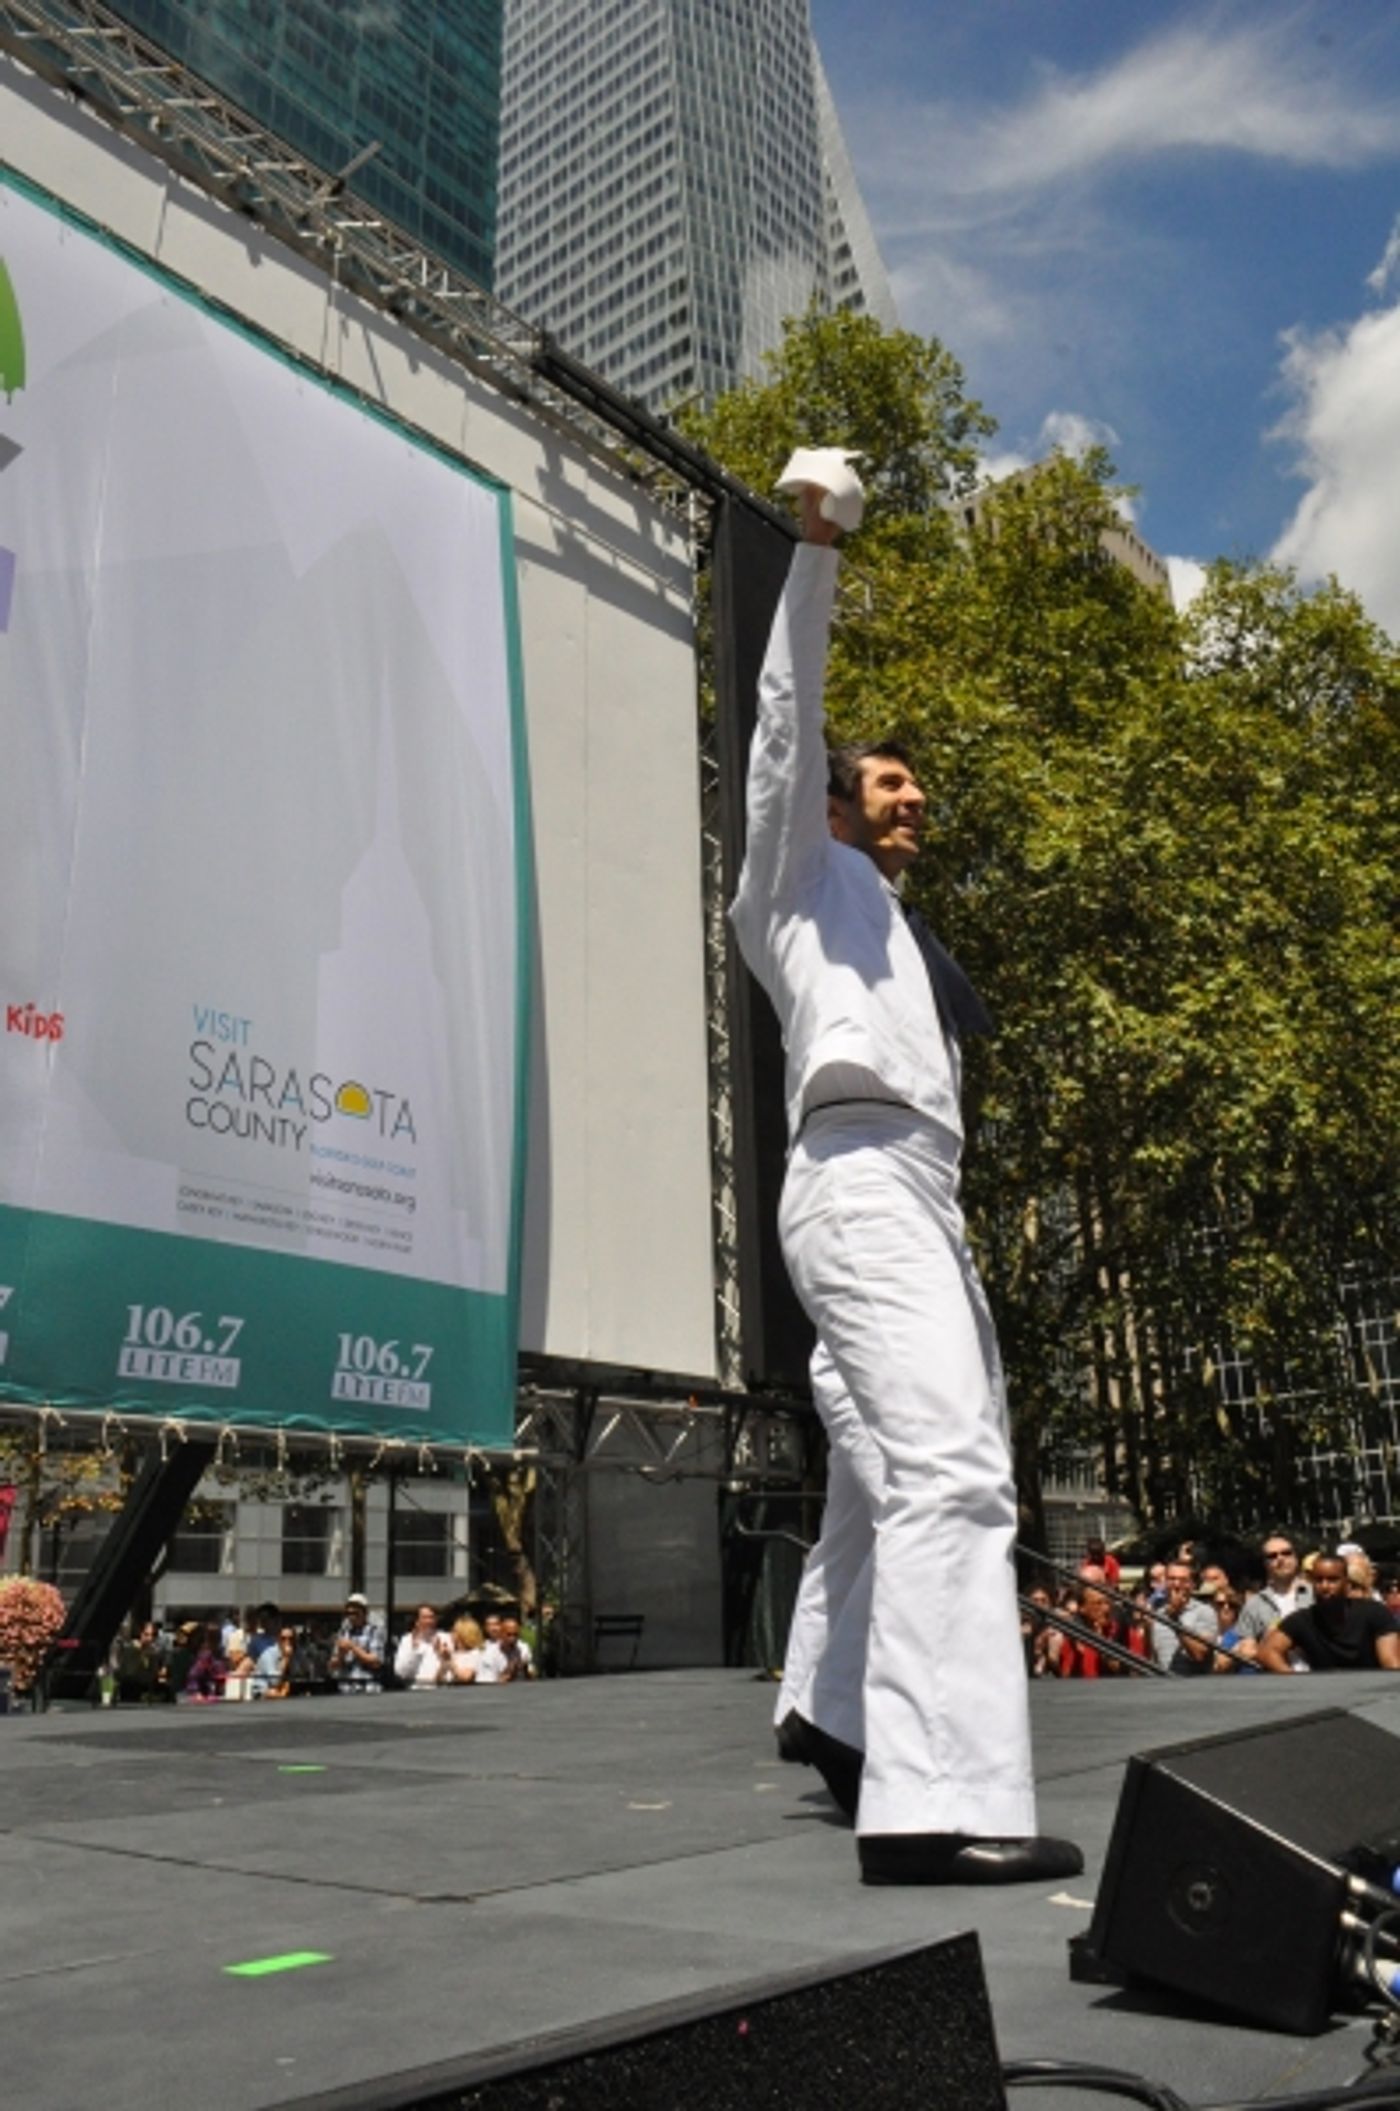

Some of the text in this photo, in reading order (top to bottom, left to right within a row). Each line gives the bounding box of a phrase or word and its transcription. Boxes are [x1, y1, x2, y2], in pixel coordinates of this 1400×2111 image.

[193, 1003, 253, 1047] VISIT
[188, 1040, 417, 1145] SARASOTA
[185, 1097, 308, 1151] COUNTY
[122, 1303, 245, 1355] 106.7
[336, 1332, 435, 1380] 106.7
